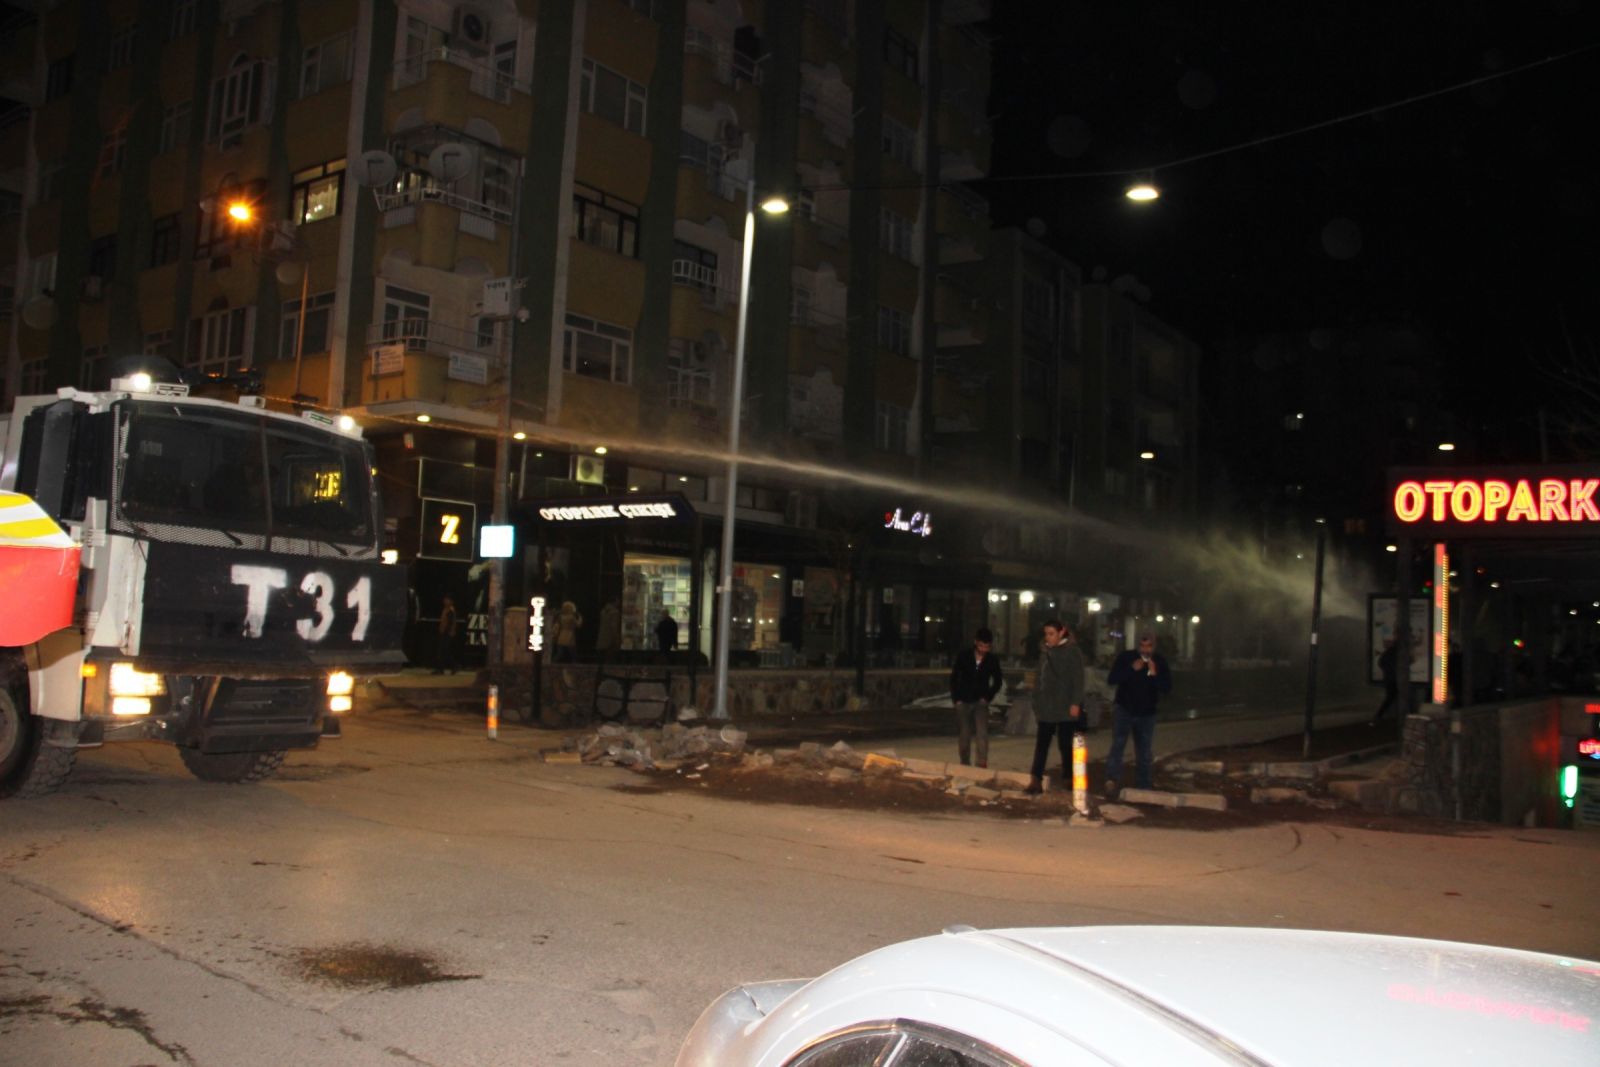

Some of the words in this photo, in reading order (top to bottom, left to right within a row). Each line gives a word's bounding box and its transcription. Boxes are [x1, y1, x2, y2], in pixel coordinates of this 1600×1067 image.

[539, 505, 620, 520] OTOPARK
[1394, 479, 1600, 522] OTOPARK
[440, 514, 461, 544] Z
